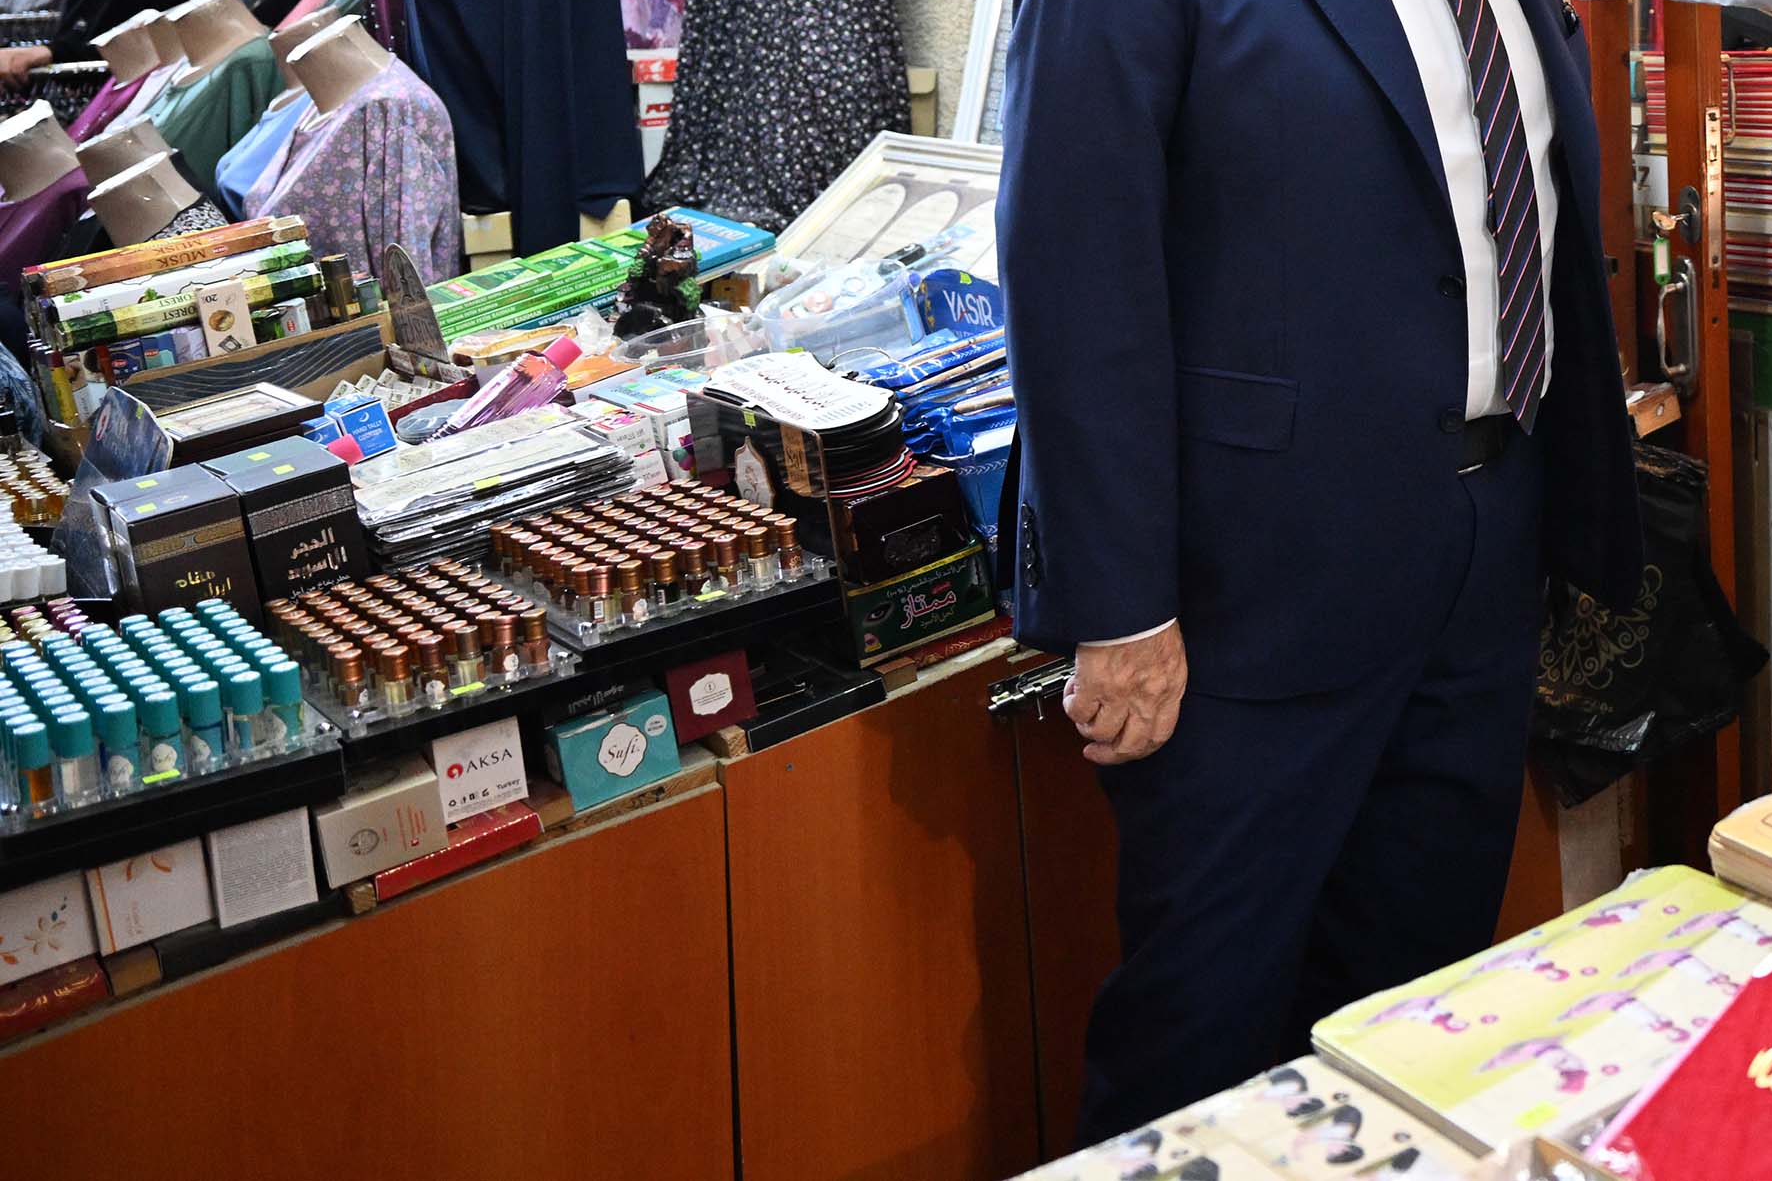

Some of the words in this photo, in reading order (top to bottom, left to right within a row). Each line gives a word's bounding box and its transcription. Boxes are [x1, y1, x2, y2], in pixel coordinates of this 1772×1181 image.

[158, 249, 207, 269] MUSK
[158, 292, 196, 308] OREST
[162, 305, 199, 323] OREST
[467, 748, 513, 773] AKSA
